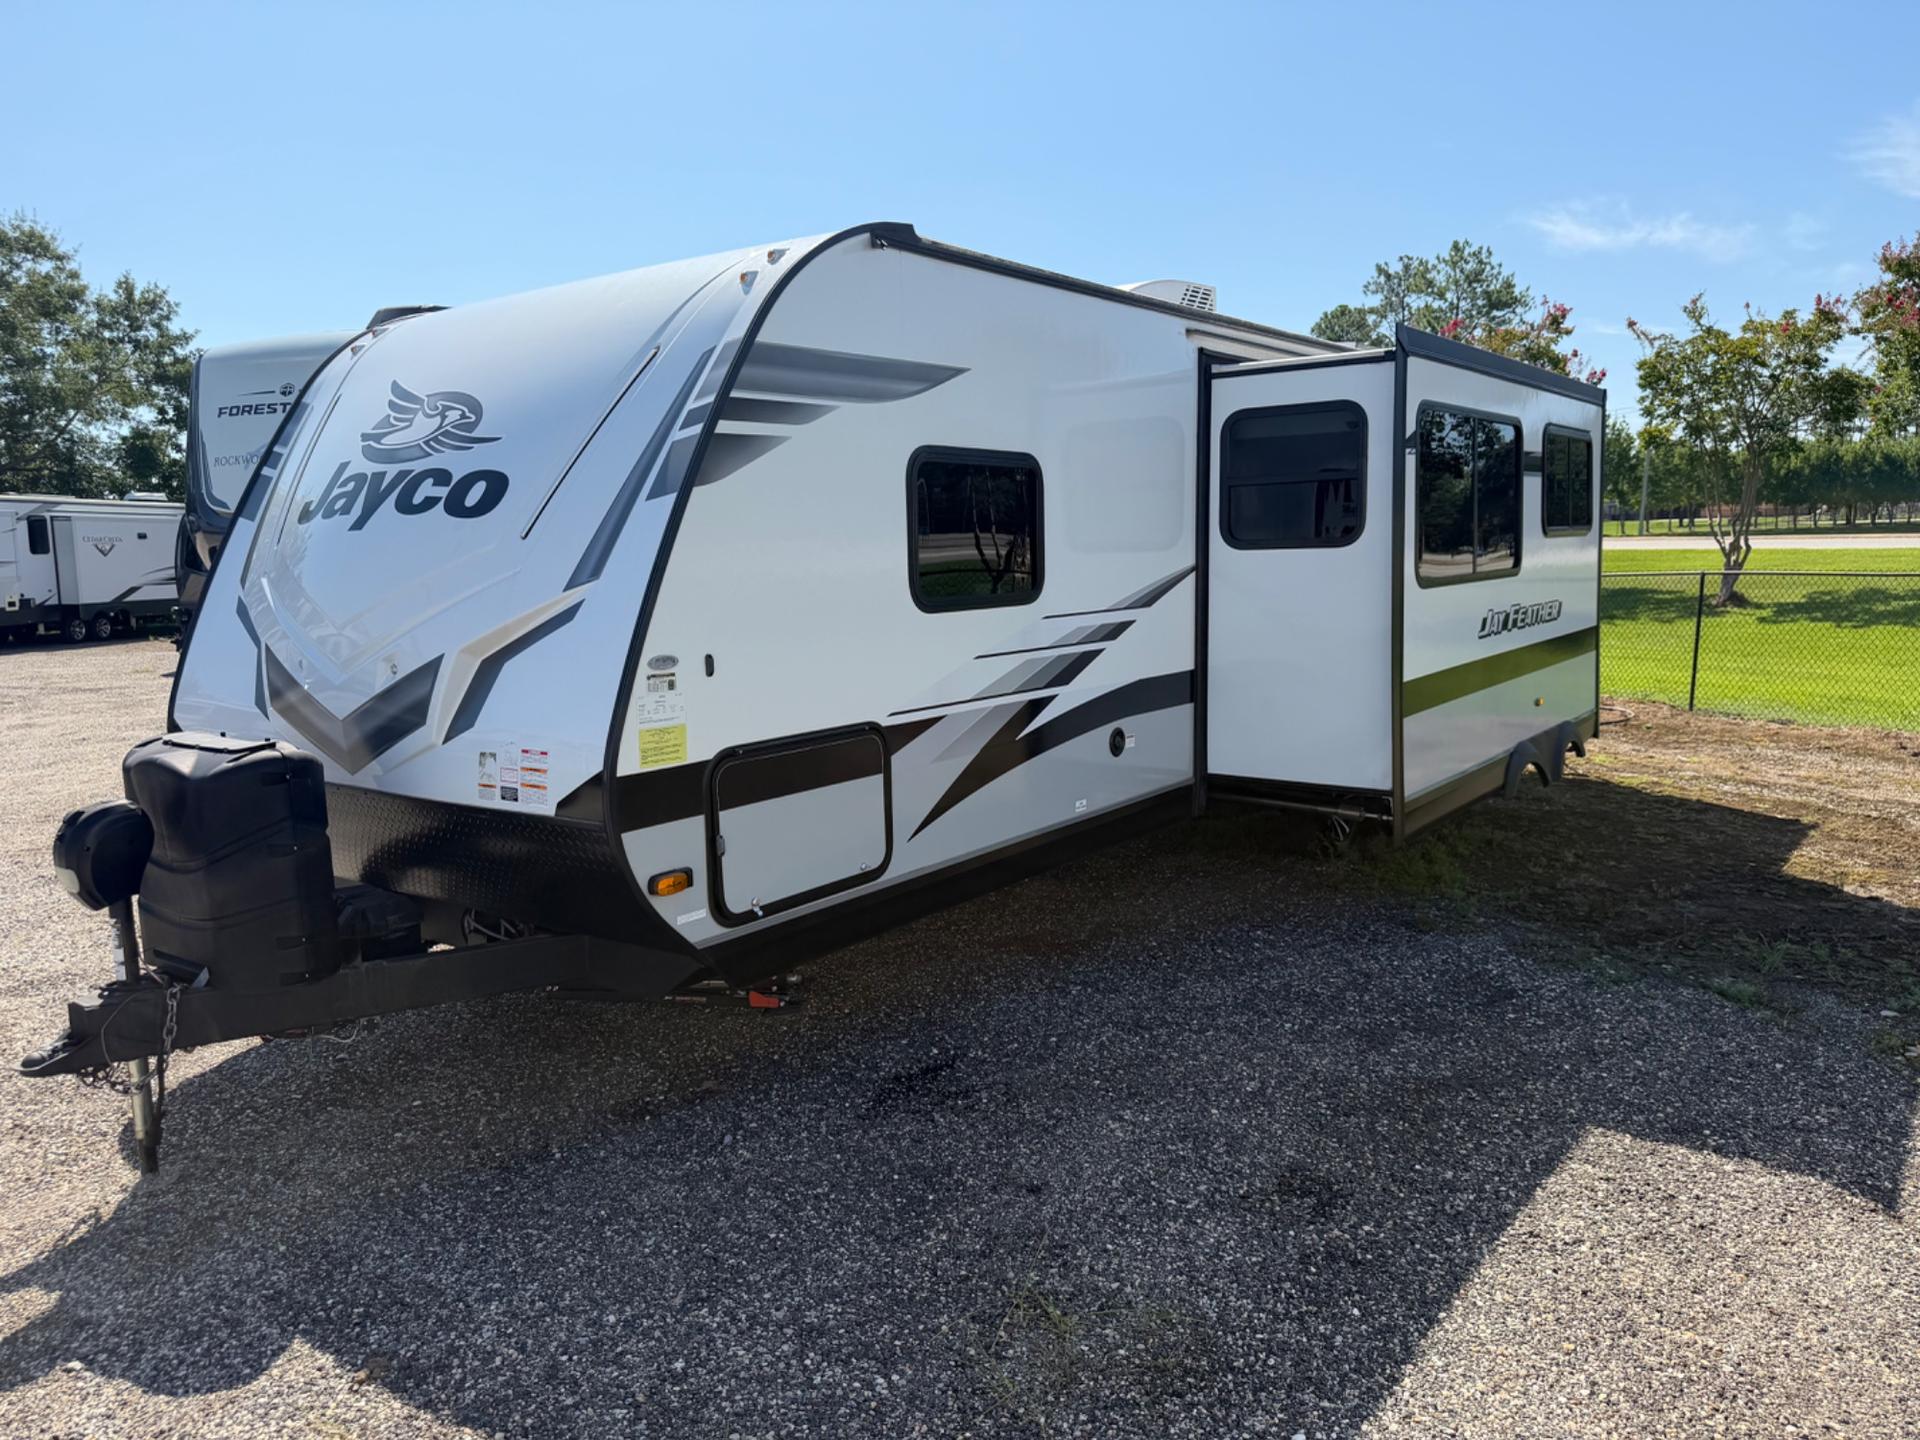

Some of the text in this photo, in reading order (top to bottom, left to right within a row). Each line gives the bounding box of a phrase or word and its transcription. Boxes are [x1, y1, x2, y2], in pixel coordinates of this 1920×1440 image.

[217, 402, 292, 418] FOREST
[297, 460, 510, 532] Jayco
[1478, 599, 1562, 639] JAY FEATHER
